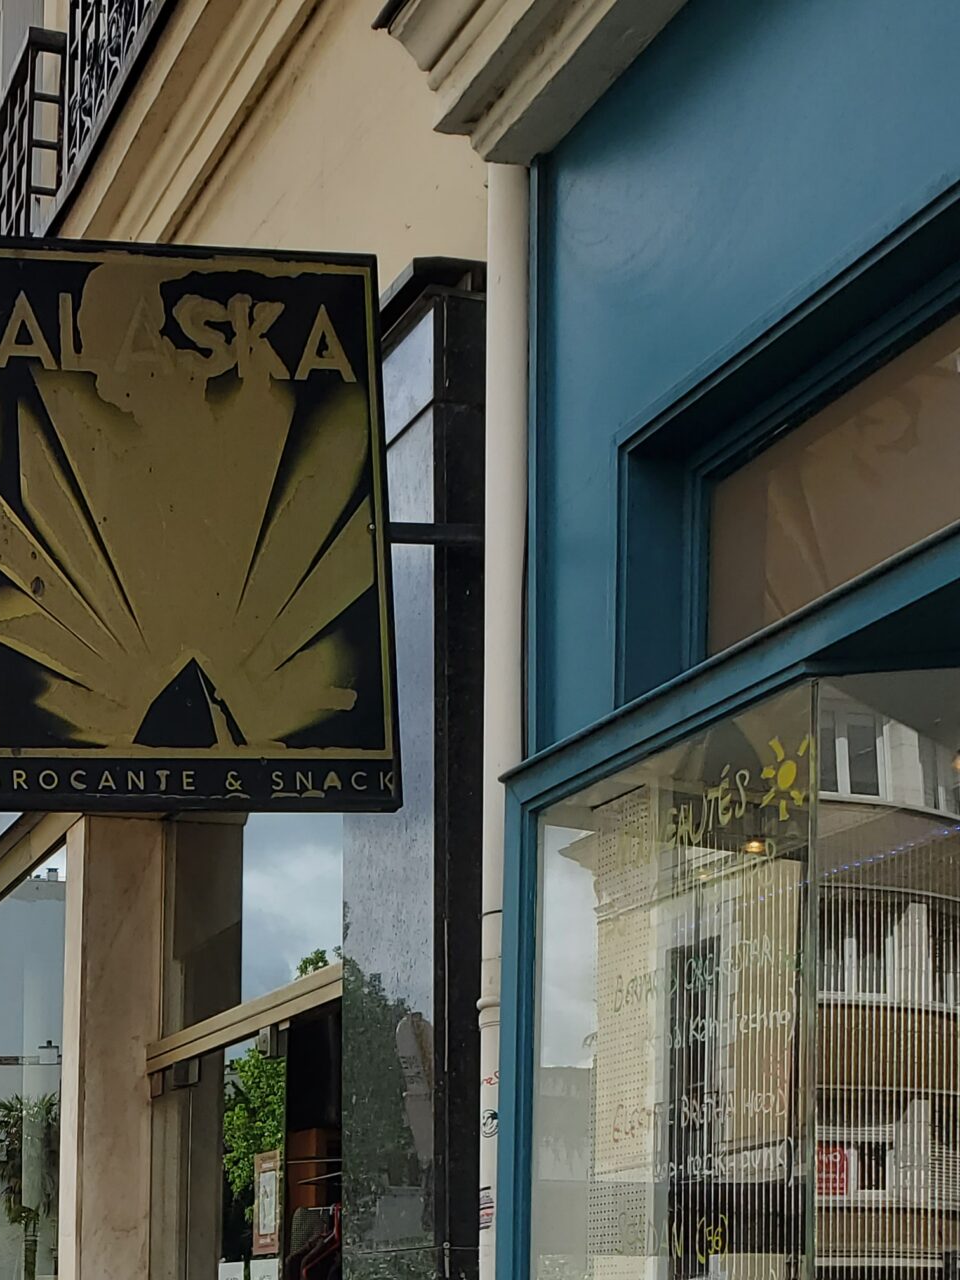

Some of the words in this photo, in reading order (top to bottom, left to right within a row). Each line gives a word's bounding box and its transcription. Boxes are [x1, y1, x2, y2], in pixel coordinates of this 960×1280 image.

[224, 769, 243, 790] &
[271, 770, 394, 792] SNACK
[616, 763, 750, 872] NVEAUTÉS
[696, 1213, 728, 1264] (56)
